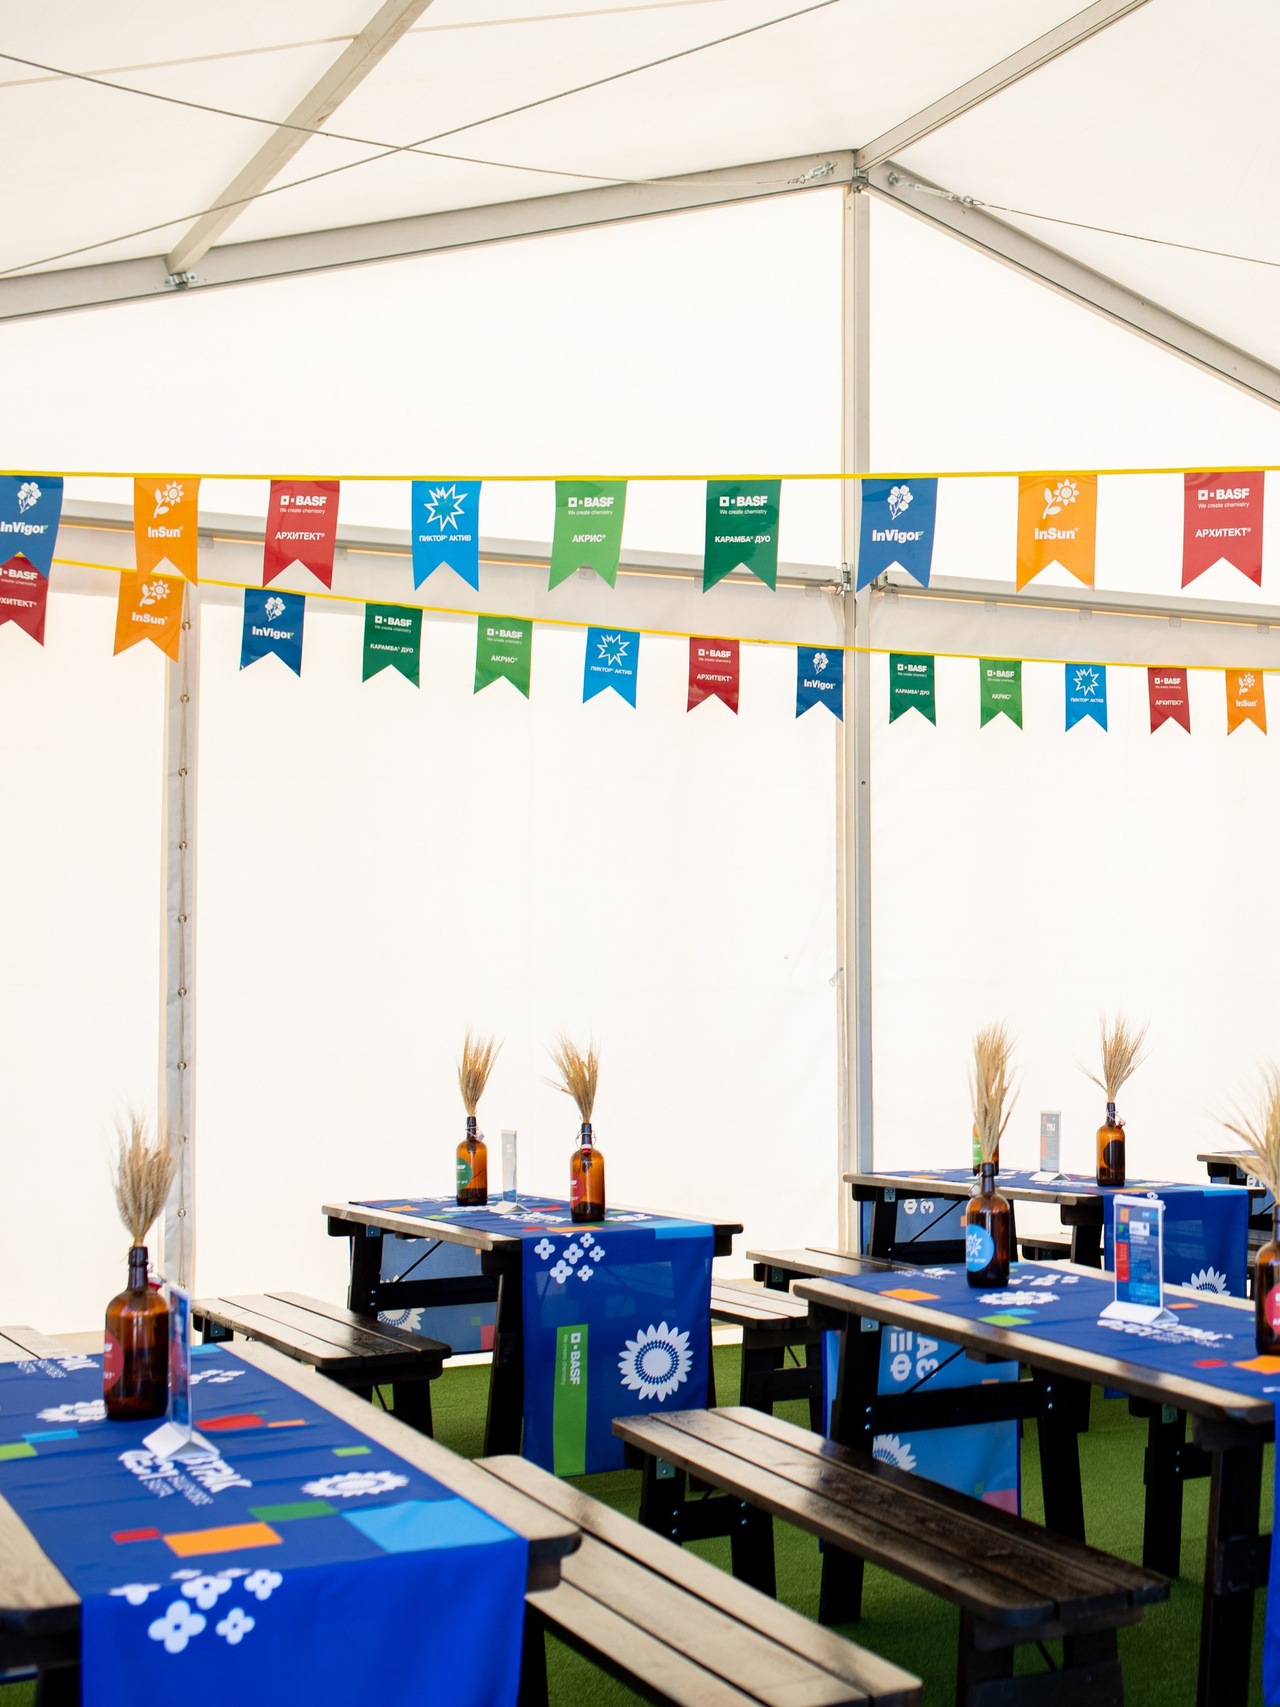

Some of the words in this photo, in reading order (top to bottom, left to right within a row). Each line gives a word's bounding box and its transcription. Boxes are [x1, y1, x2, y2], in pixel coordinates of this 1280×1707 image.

[1215, 488, 1250, 500] BASF
[296, 496, 327, 506] BASF
[584, 497, 615, 508] BASF
[736, 496, 768, 507] BASF
[1, 522, 48, 535] InVigor
[754, 536, 771, 544] ДУО
[872, 530, 924, 544] InVigor
[8, 569, 38, 580] BASF
[387, 617, 413, 627] BASF
[252, 626, 294, 640] InVigor
[499, 629, 523, 639] BASF
[709, 649, 732, 658] BASF
[907, 664, 928, 673] BASF
[996, 670, 1015, 678] BASF
[803, 679, 836, 690] InVigor
[570, 1350, 581, 1385] BASF
